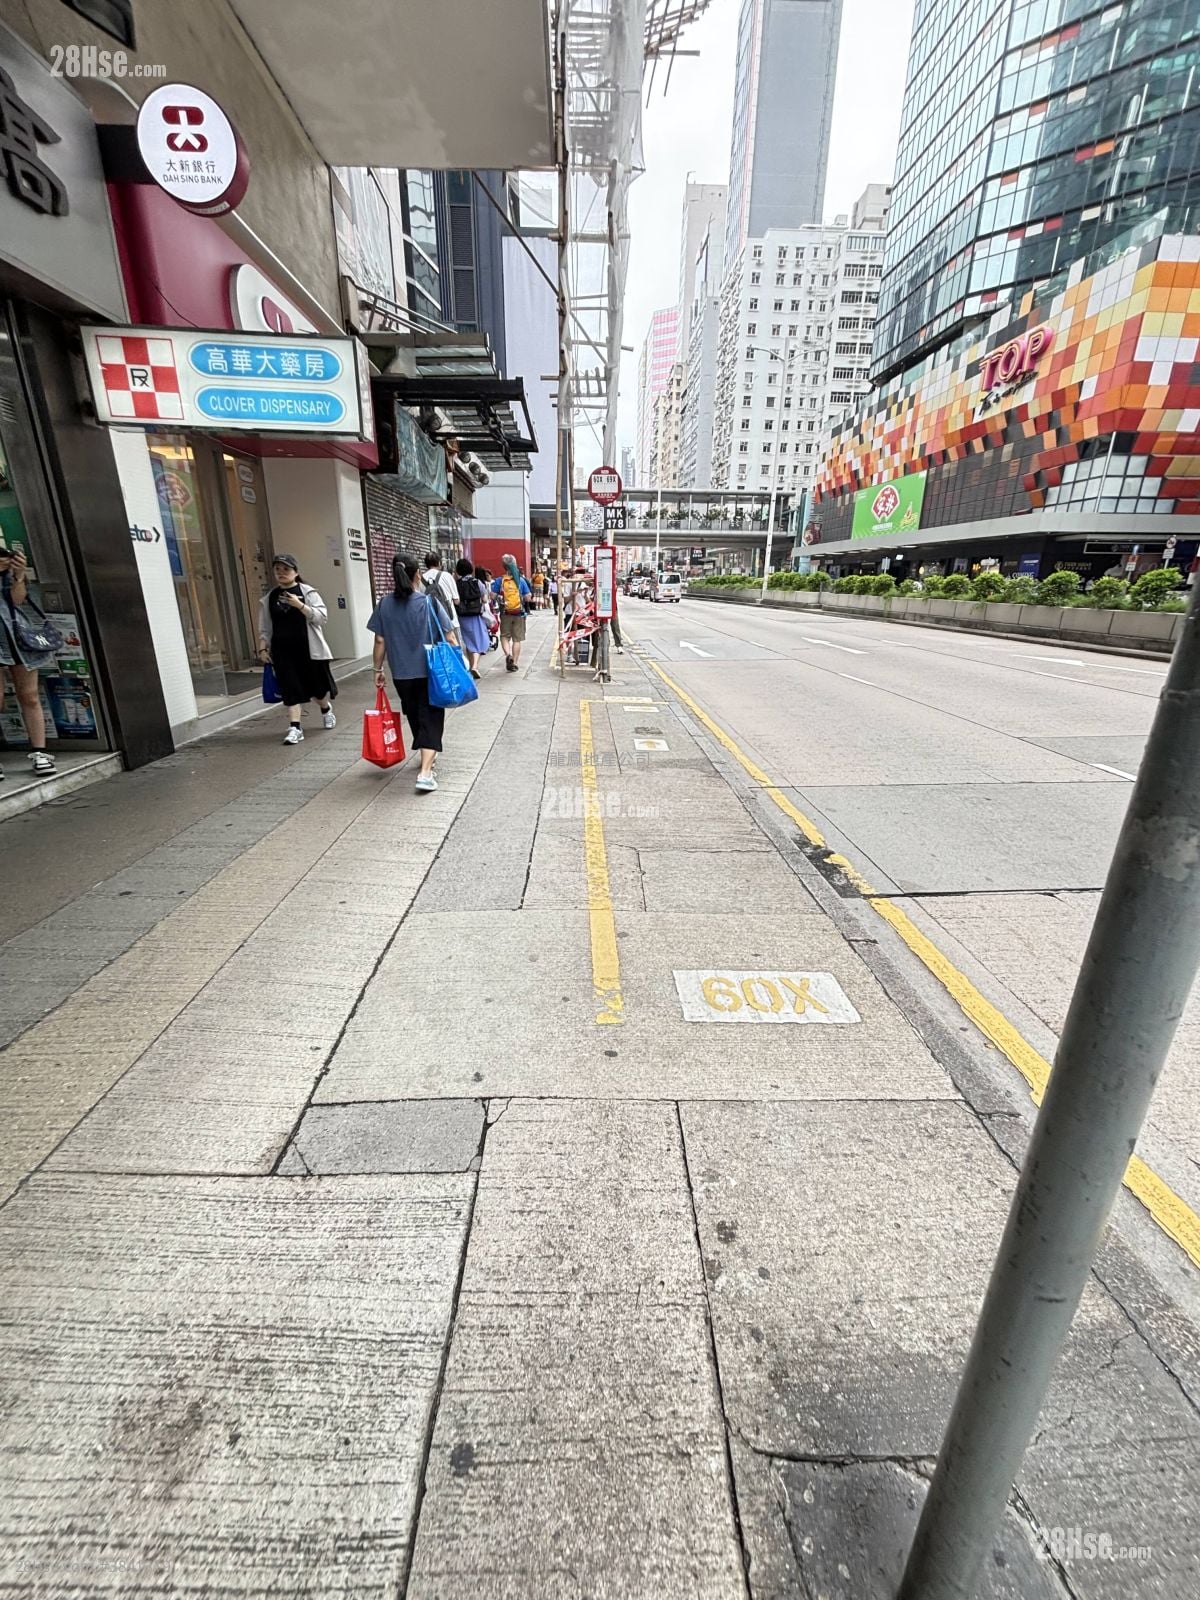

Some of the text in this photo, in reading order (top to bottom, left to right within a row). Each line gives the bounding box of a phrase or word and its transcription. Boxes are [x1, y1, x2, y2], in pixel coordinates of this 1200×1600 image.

[165, 159, 216, 173] 大新銀行
[163, 174, 223, 184] DAH SING BANK
[206, 347, 325, 378] 高華大藥房
[209, 395, 331, 416] CLOVER DISPENSARY
[606, 508, 623, 518] MK
[606, 519, 624, 529] 178
[702, 976, 830, 1014] 60X
